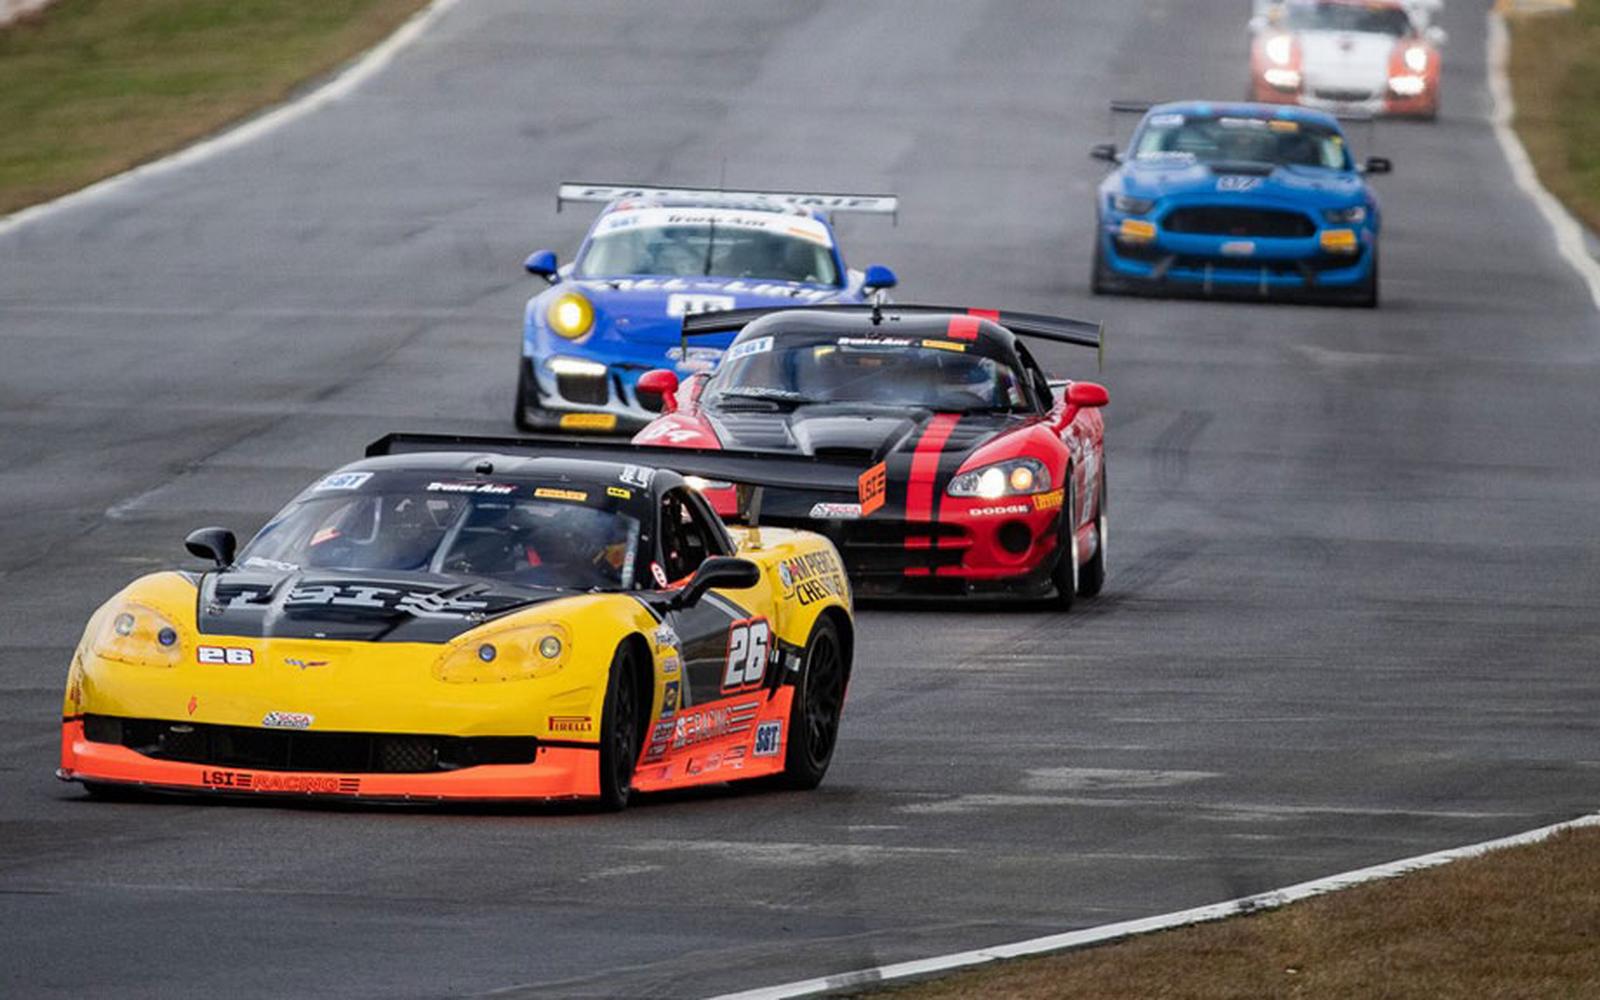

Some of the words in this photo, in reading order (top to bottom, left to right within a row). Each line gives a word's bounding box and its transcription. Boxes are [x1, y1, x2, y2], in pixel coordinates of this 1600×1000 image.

[969, 504, 1030, 517] DODGE
[197, 646, 253, 664] 26
[722, 620, 769, 690] 26
[548, 715, 592, 731] PIRELLI
[202, 771, 235, 786] LSI
[253, 774, 338, 792] RACING
